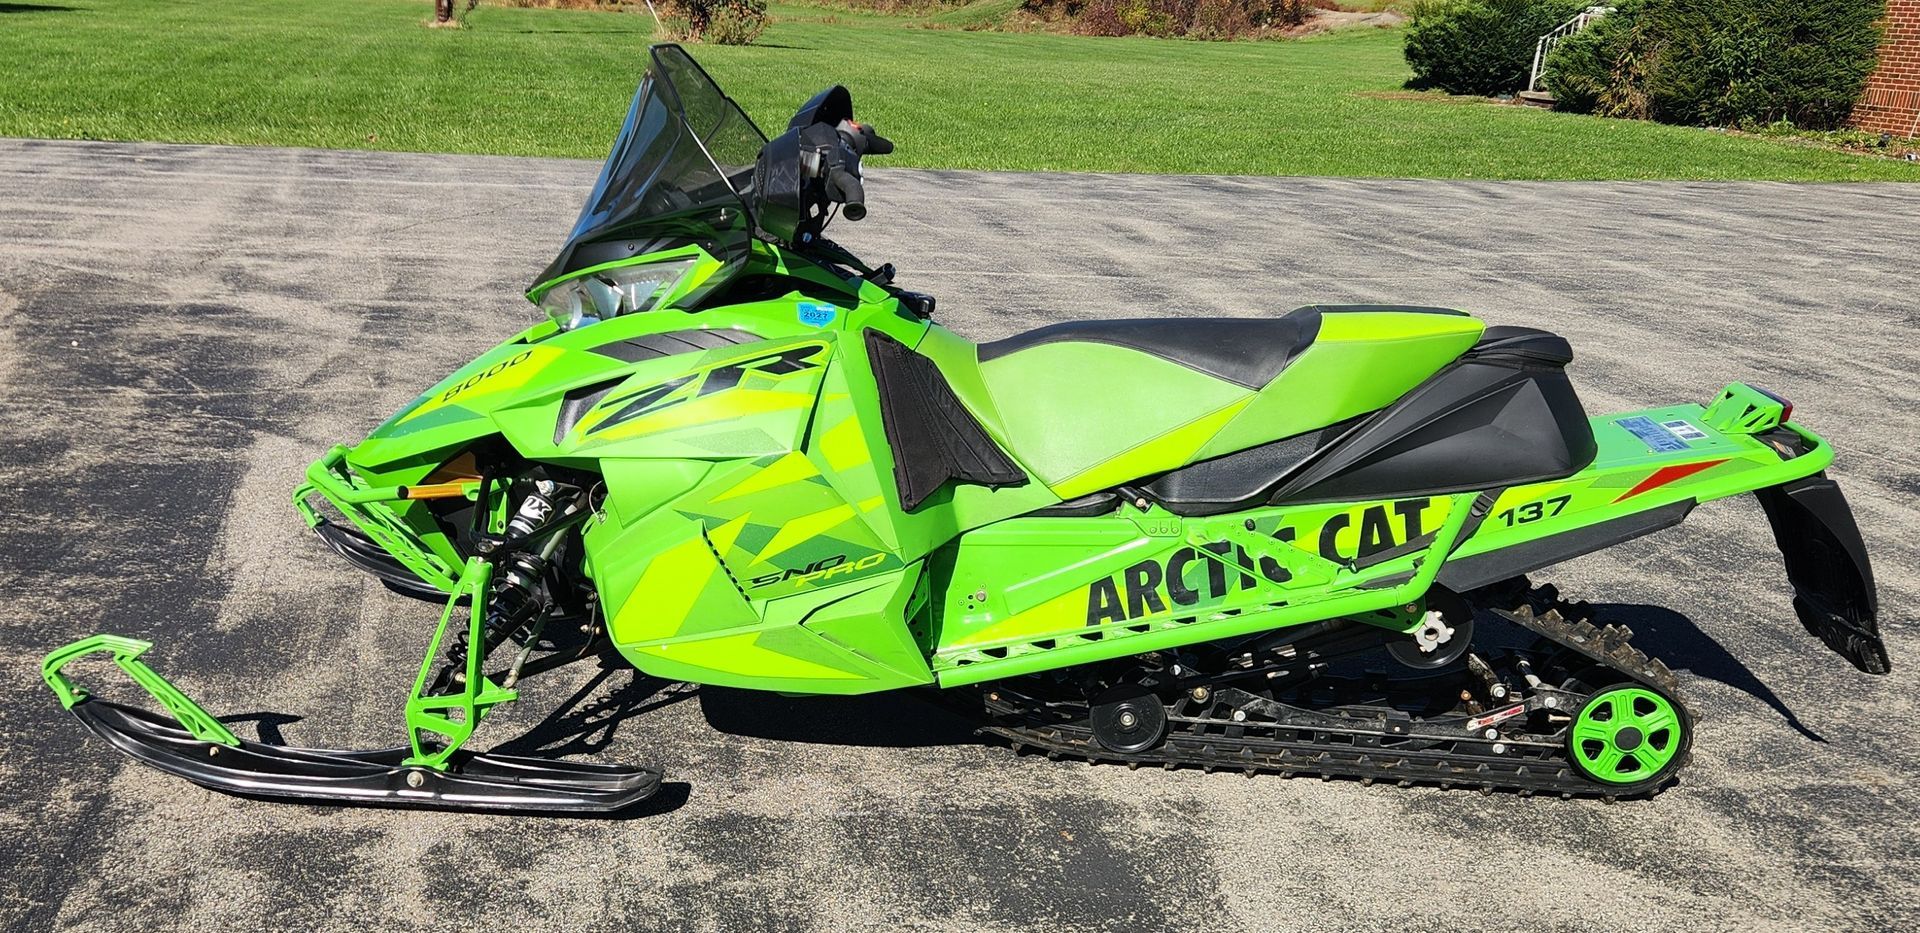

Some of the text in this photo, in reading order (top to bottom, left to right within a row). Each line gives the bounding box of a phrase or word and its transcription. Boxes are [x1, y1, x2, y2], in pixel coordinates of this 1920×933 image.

[443, 350, 533, 402] 8000
[586, 345, 824, 435] ZR
[1319, 497, 1431, 566] CAT
[1498, 494, 1572, 527] 137
[750, 553, 886, 589] SNO PRO
